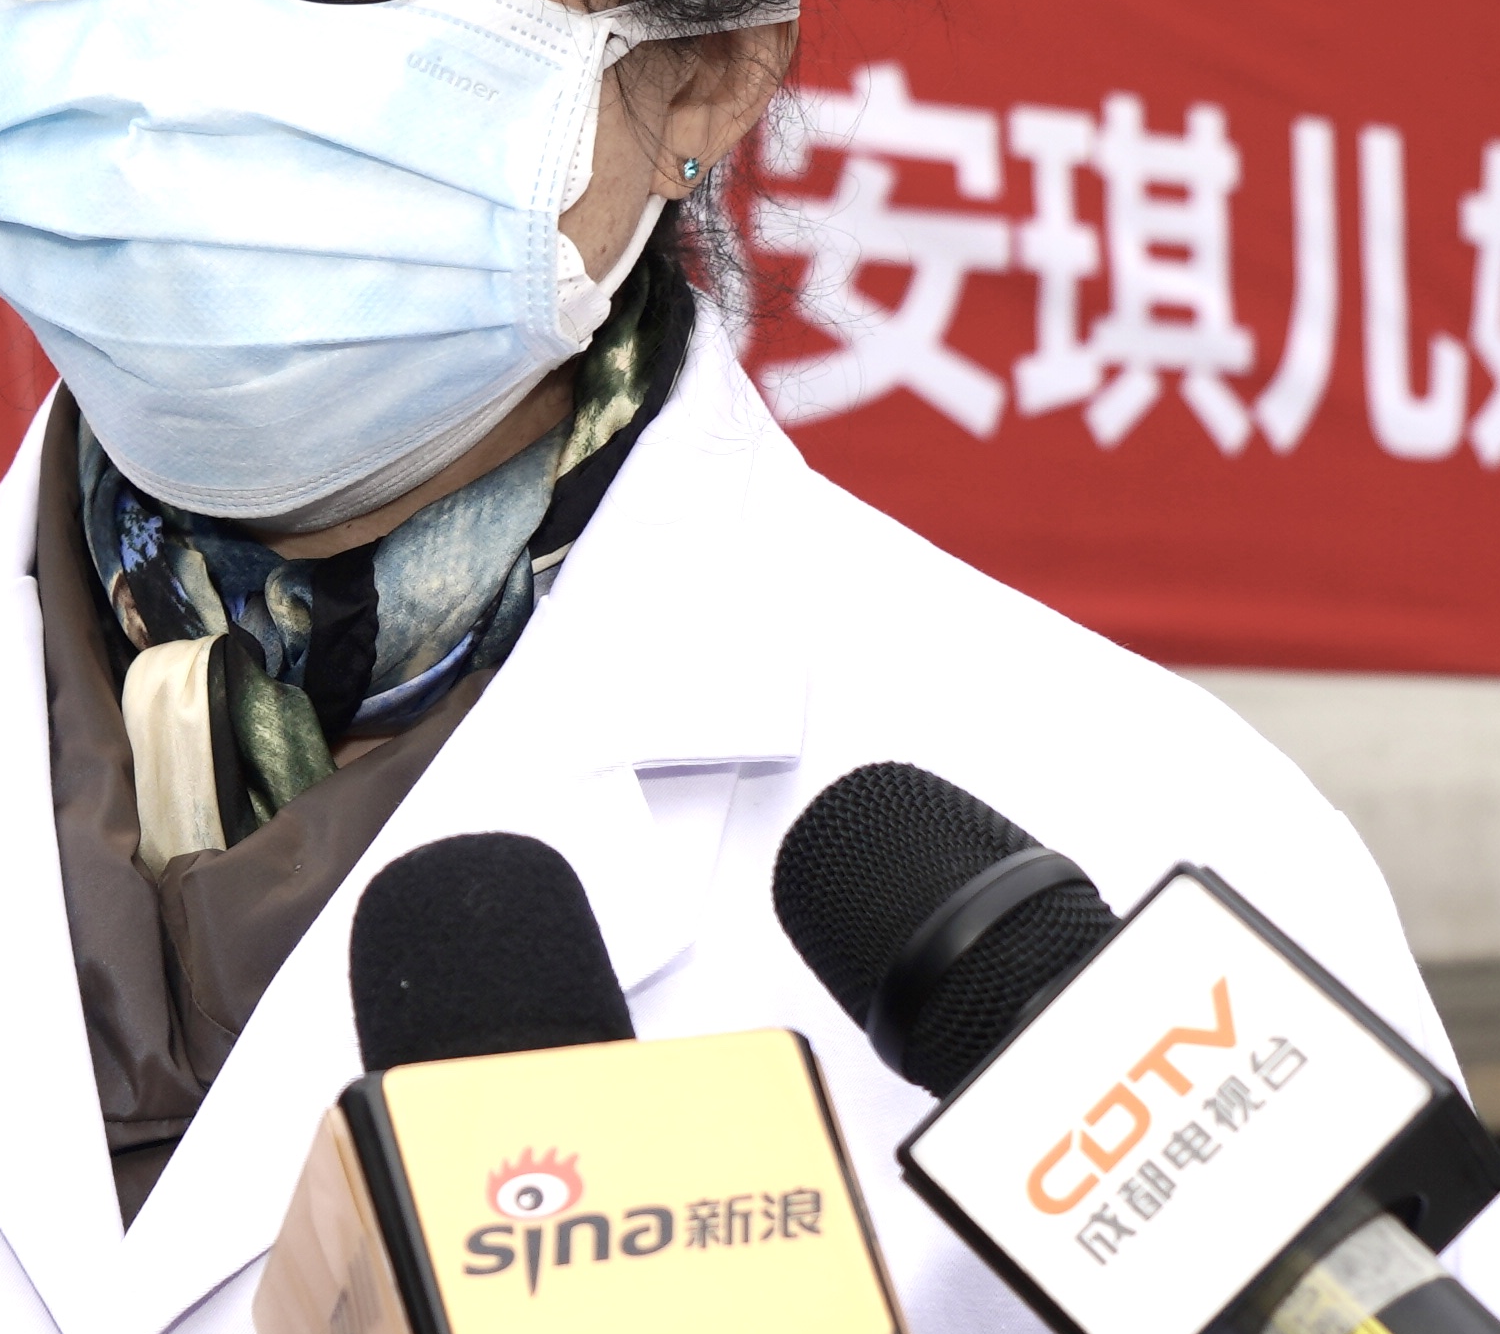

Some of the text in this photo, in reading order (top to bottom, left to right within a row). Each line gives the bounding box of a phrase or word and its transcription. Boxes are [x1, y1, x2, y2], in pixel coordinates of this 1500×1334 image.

[406, 51, 500, 101] winner
[1026, 975, 1237, 1216] CDTV
[1074, 1035, 1309, 1267] 成都电视台
[463, 1186, 823, 1297] sina 新浪
